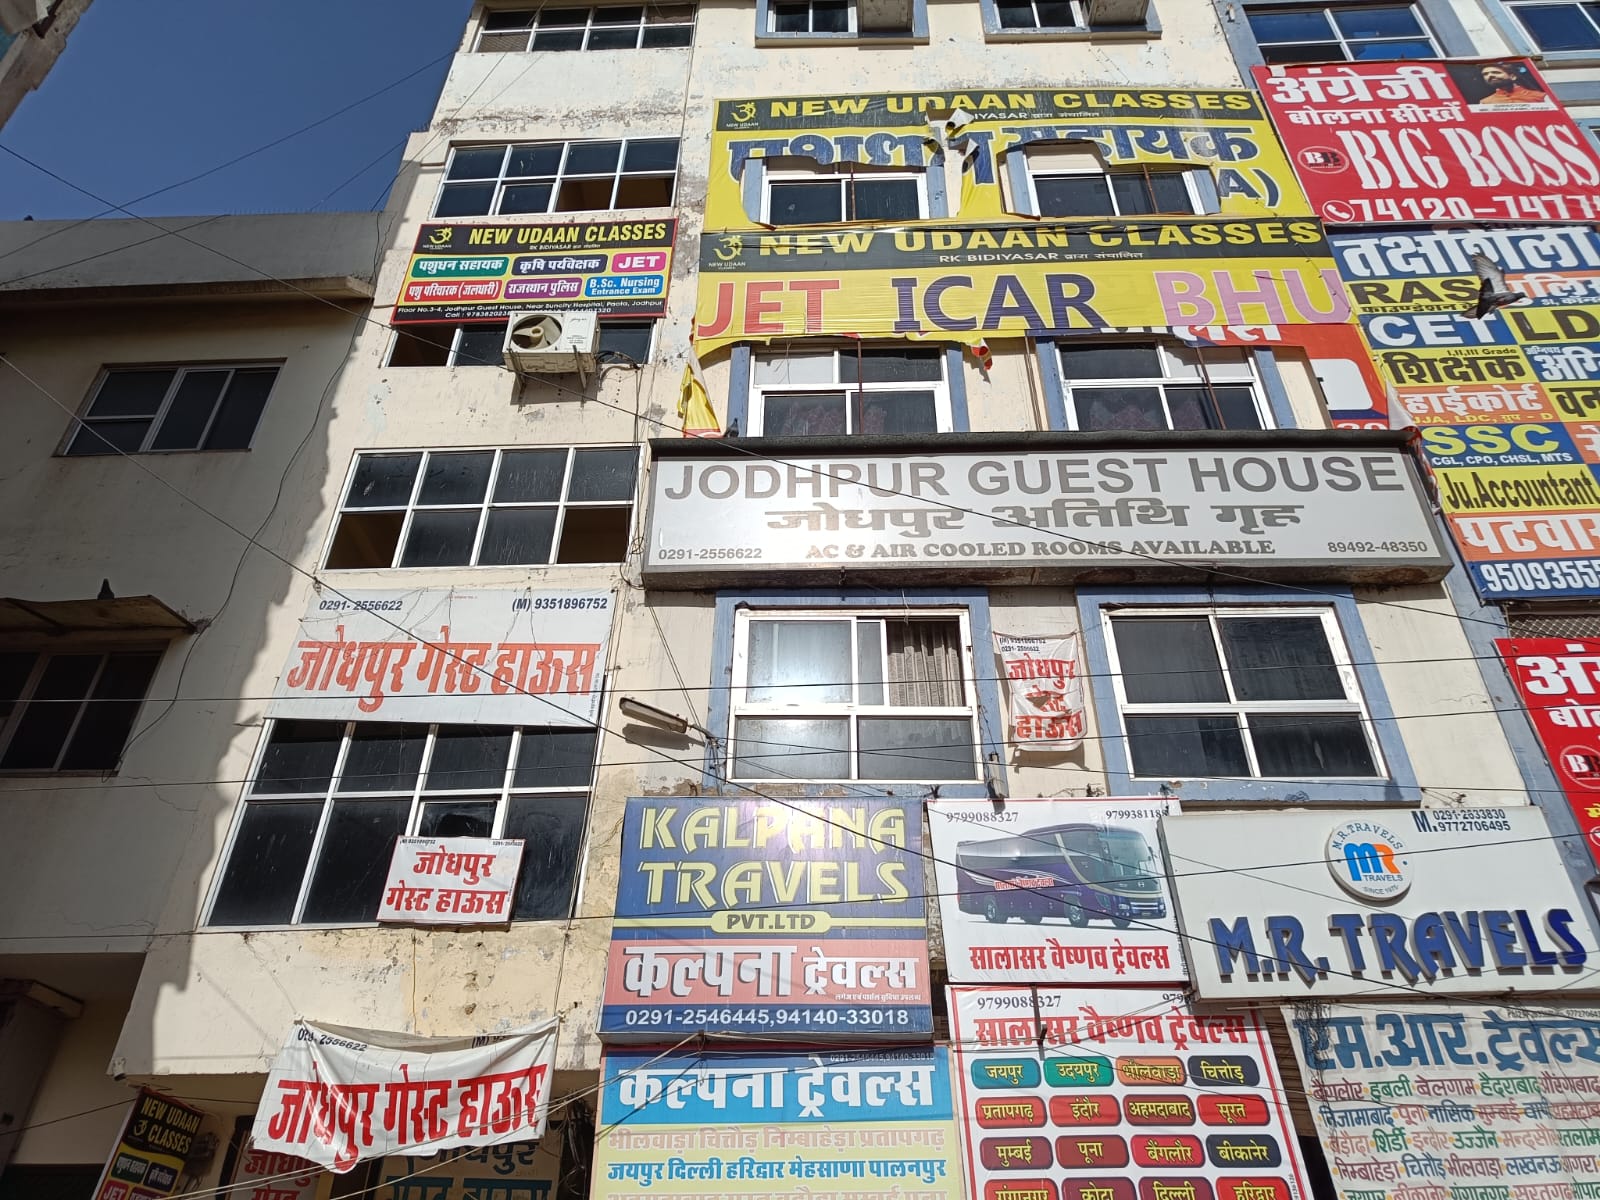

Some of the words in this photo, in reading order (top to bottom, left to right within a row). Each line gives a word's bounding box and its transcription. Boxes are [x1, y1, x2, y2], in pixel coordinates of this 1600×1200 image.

[771, 98, 870, 117] NEW
[886, 92, 1043, 113] UDAAN
[1053, 91, 1252, 112] CLASSES
[1285, 105, 1385, 126] बोलना
[1336, 127, 1450, 190] BIG
[1440, 124, 1600, 188] BOSS
[469, 228, 512, 245] NEW
[517, 225, 582, 244] UDAAN
[585, 223, 667, 242] CLASSES
[760, 231, 876, 257] NEW
[894, 226, 1070, 253] UDAAN
[1089, 220, 1323, 248] CLASSES
[419, 260, 457, 275] पशुधन
[459, 258, 504, 271] सहायक
[519, 257, 546, 274] कृषि
[618, 255, 661, 269] JET
[939, 255, 961, 263] RK
[967, 252, 1059, 262] BIDIYASAR
[549, 279, 579, 299] पुलिस
[590, 277, 618, 288] B.Sc.
[620, 276, 660, 289] Nursing
[592, 288, 631, 296] Entrance
[632, 287, 656, 295] Exam
[1350, 279, 1482, 305] RAS
[698, 279, 841, 338] JET
[891, 272, 1111, 332] ICAR
[1153, 269, 1352, 328] BHU
[1368, 313, 1498, 346] CET
[1482, 347, 1517, 355] Grade
[1384, 351, 1527, 384] शिक्षक
[1421, 423, 1560, 456] SSC
[1432, 456, 1463, 467] CGL,
[1466, 455, 1498, 465] CPO,
[1500, 454, 1540, 464] CHSL,
[1542, 453, 1573, 462] MTS
[665, 461, 950, 500] JODHPUR
[967, 457, 1168, 497] GUEST
[1188, 456, 1405, 493] HOUSE
[765, 502, 973, 539] जोधपुर
[991, 497, 1191, 531] अतिथि
[1210, 504, 1305, 536] गृह
[658, 548, 762, 561] 0291-2556622
[805, 544, 839, 559] AC
[871, 543, 918, 558] AIR
[927, 541, 1028, 557] COOLED
[1032, 541, 1122, 556] ROOMS
[1130, 539, 1276, 556] AVAILABLE
[1327, 540, 1428, 553] 89492-48350
[354, 600, 402, 611] 2556622
[512, 598, 532, 612] (M)
[534, 598, 608, 611] 9351896752
[287, 624, 417, 713] जोधपुर
[416, 625, 492, 694] गेस्ट
[490, 642, 601, 697] हाऊस
[639, 806, 906, 855] KALPANA
[946, 811, 1019, 824] 9799088327
[1438, 820, 1511, 832] 9772706495
[413, 845, 497, 886] जोधपुर
[1362, 874, 1404, 882] TRAVELS
[386, 879, 435, 911] गेस्ट
[435, 888, 509, 914] हाऊस
[637, 860, 910, 910] TRAVELS
[727, 914, 816, 930] PVT.LTD
[968, 945, 1048, 970] सालासर
[1045, 938, 1108, 970] वैष्णव
[1110, 938, 1170, 975] ट्रेवल्स
[1328, 908, 1589, 988] TRAVELS
[623, 945, 798, 998] कल्पना
[801, 946, 920, 995] ट्रेवल्स
[625, 1008, 910, 1027] 0291-2546445,94140-33018
[1078, 1005, 1164, 1045] वैष्णव
[618, 1064, 790, 1111] कल्पना
[794, 1055, 937, 1118] ट्रेवल्स
[985, 1062, 1025, 1085] जयपुर
[1055, 1062, 1101, 1084] उदयपुर
[141, 1097, 167, 1120] NEW
[167, 1105, 201, 1135] UDAAN
[383, 1063, 452, 1145] गेस्ट
[981, 1102, 1036, 1123] प्रतापगढ़
[1069, 1097, 1101, 1121] इंदौर
[1128, 1100, 1192, 1121] अहमदाबाद
[1216, 1102, 1247, 1124] सूरत
[148, 1124, 193, 1154] CLASSES
[995, 1139, 1033, 1164] मुम्बई
[1076, 1141, 1104, 1163] पूना
[1216, 1138, 1270, 1162] बीकानेर
[607, 1161, 663, 1188] जयपुर
[666, 1156, 724, 1181] दिल्ली
[726, 1156, 785, 1182] हरिद्वार
[788, 1155, 867, 1180] मेहसाणा
[869, 1158, 947, 1184] पालनपुर
